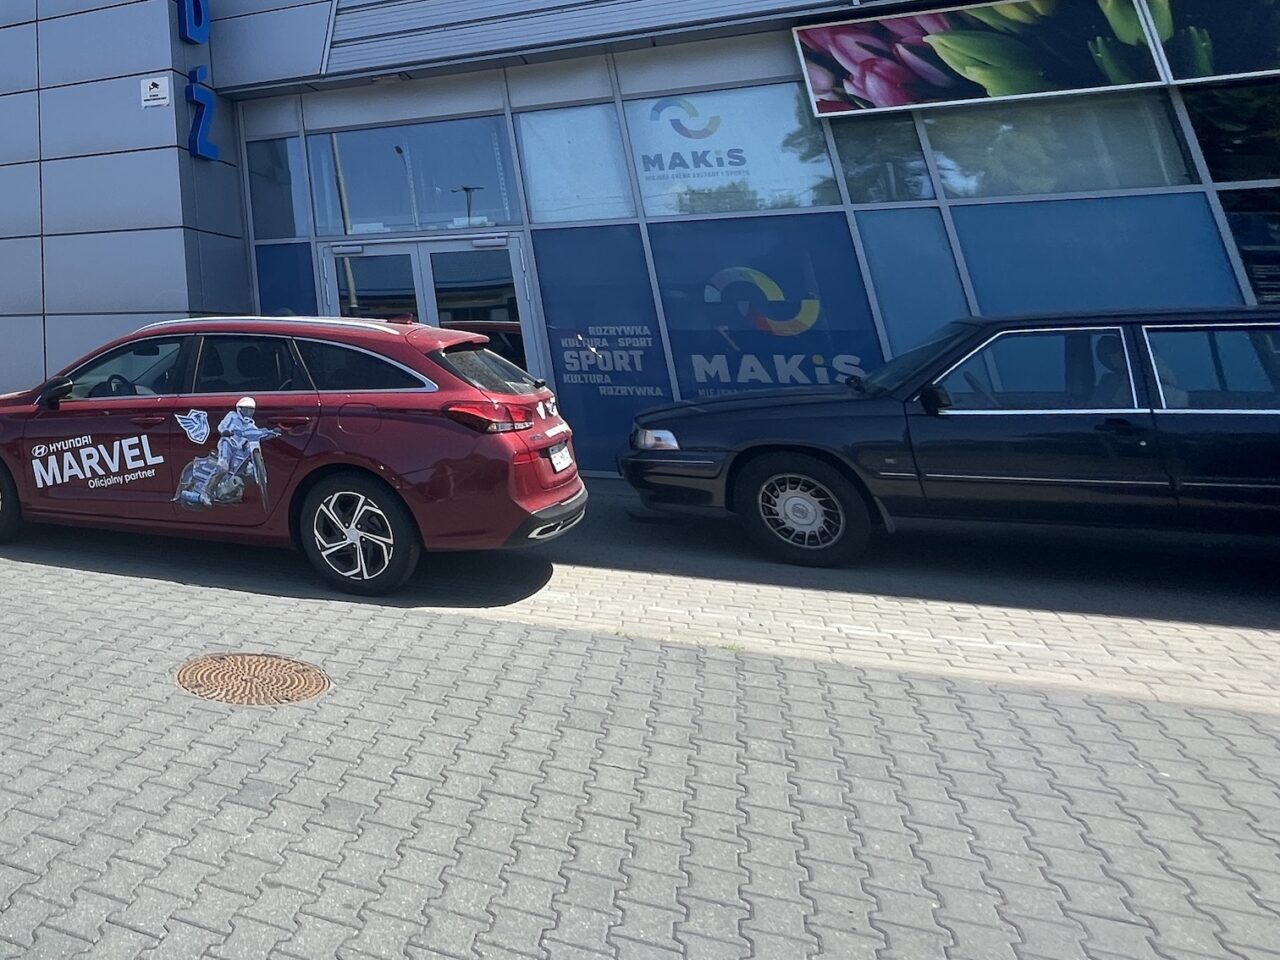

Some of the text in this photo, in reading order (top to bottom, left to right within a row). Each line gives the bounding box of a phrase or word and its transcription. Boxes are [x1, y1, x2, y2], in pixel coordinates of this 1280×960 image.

[588, 325, 651, 336] ROZRYWKA
[617, 337, 653, 347] SPORT
[563, 350, 644, 372] SPORT
[563, 373, 612, 384] KULTURA
[599, 385, 664, 397] ROZRYWKA
[49, 434, 93, 453] HYUNDAI
[31, 434, 165, 489] MARVEL
[88, 468, 156, 489] Oficjalny partner
